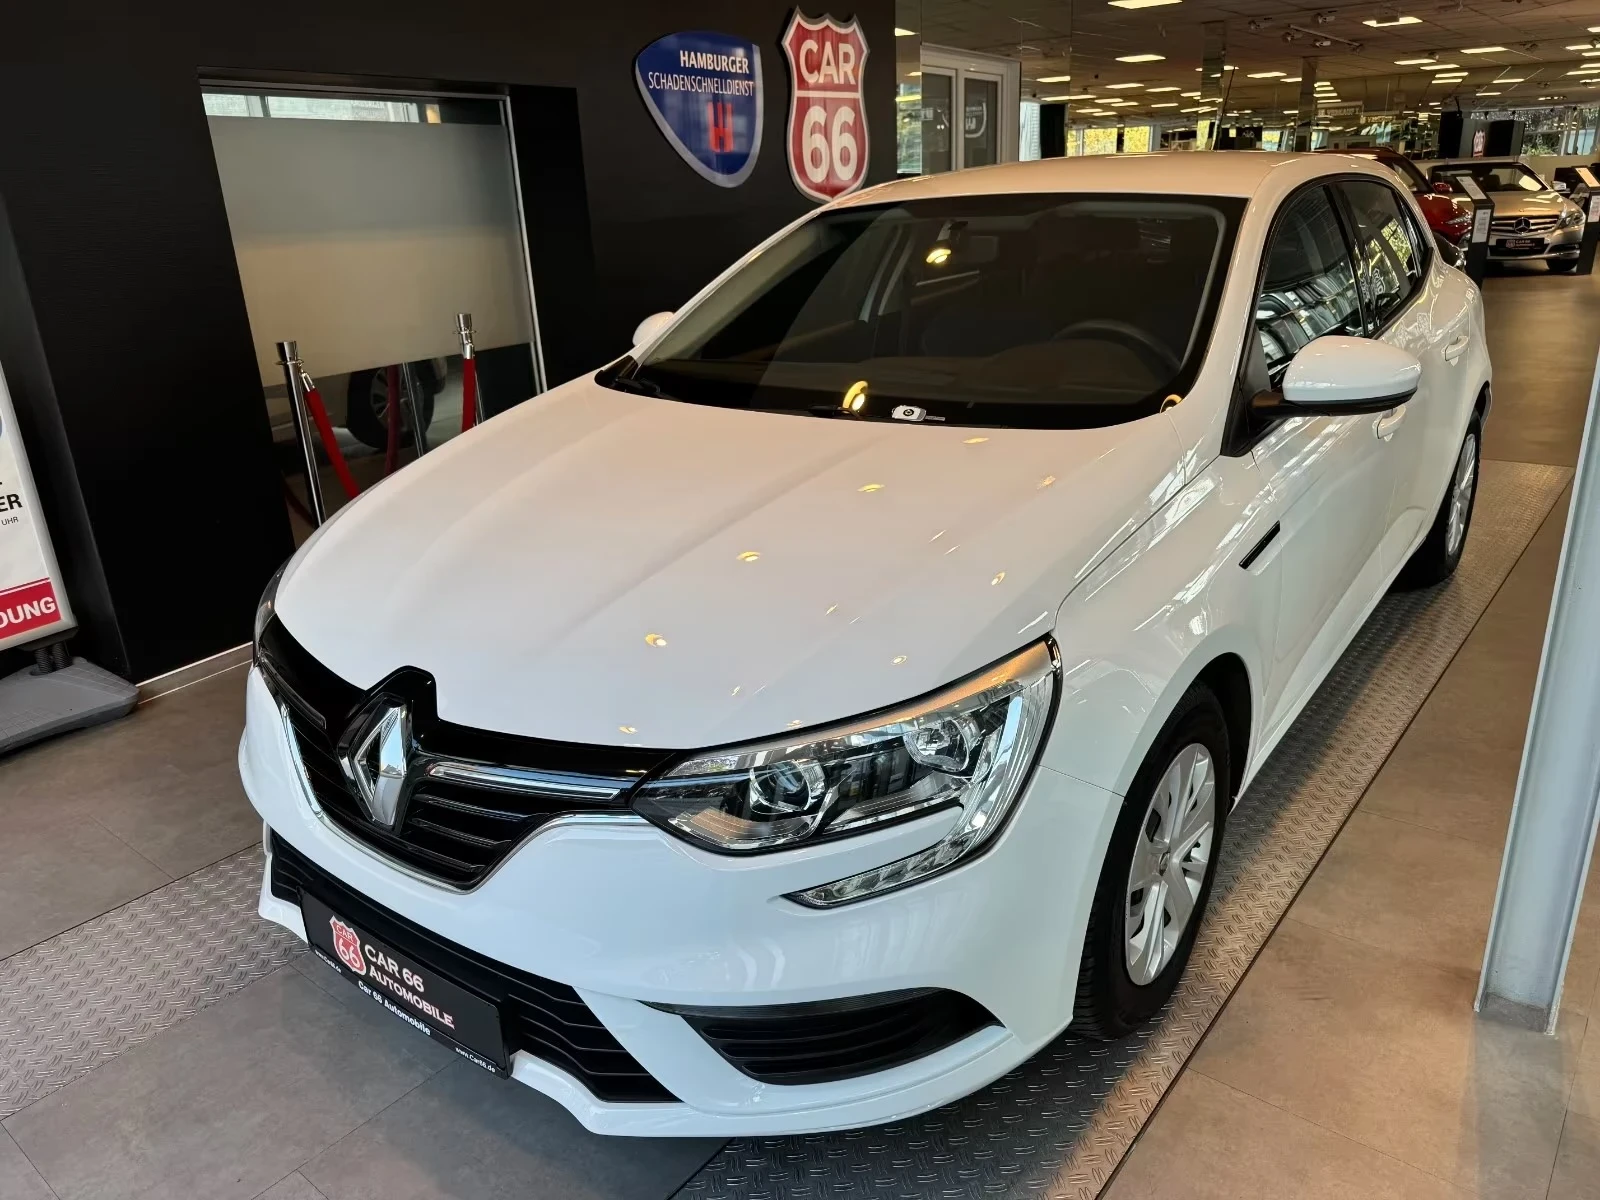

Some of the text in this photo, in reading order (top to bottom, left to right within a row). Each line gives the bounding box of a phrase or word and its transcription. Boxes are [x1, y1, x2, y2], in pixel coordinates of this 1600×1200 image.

[680, 50, 749, 74] HAMBURGER
[800, 39, 856, 85] CAR
[648, 71, 754, 97] SCHADENSCHNELLDIENST
[801, 105, 858, 184] 66
[1, 516, 19, 526] UHR
[336, 925, 353, 942] CAR
[338, 938, 360, 968] 66
[364, 944, 424, 993] CAR 66
[358, 980, 372, 996] Car
[369, 964, 455, 1030] AUTOMOBILE
